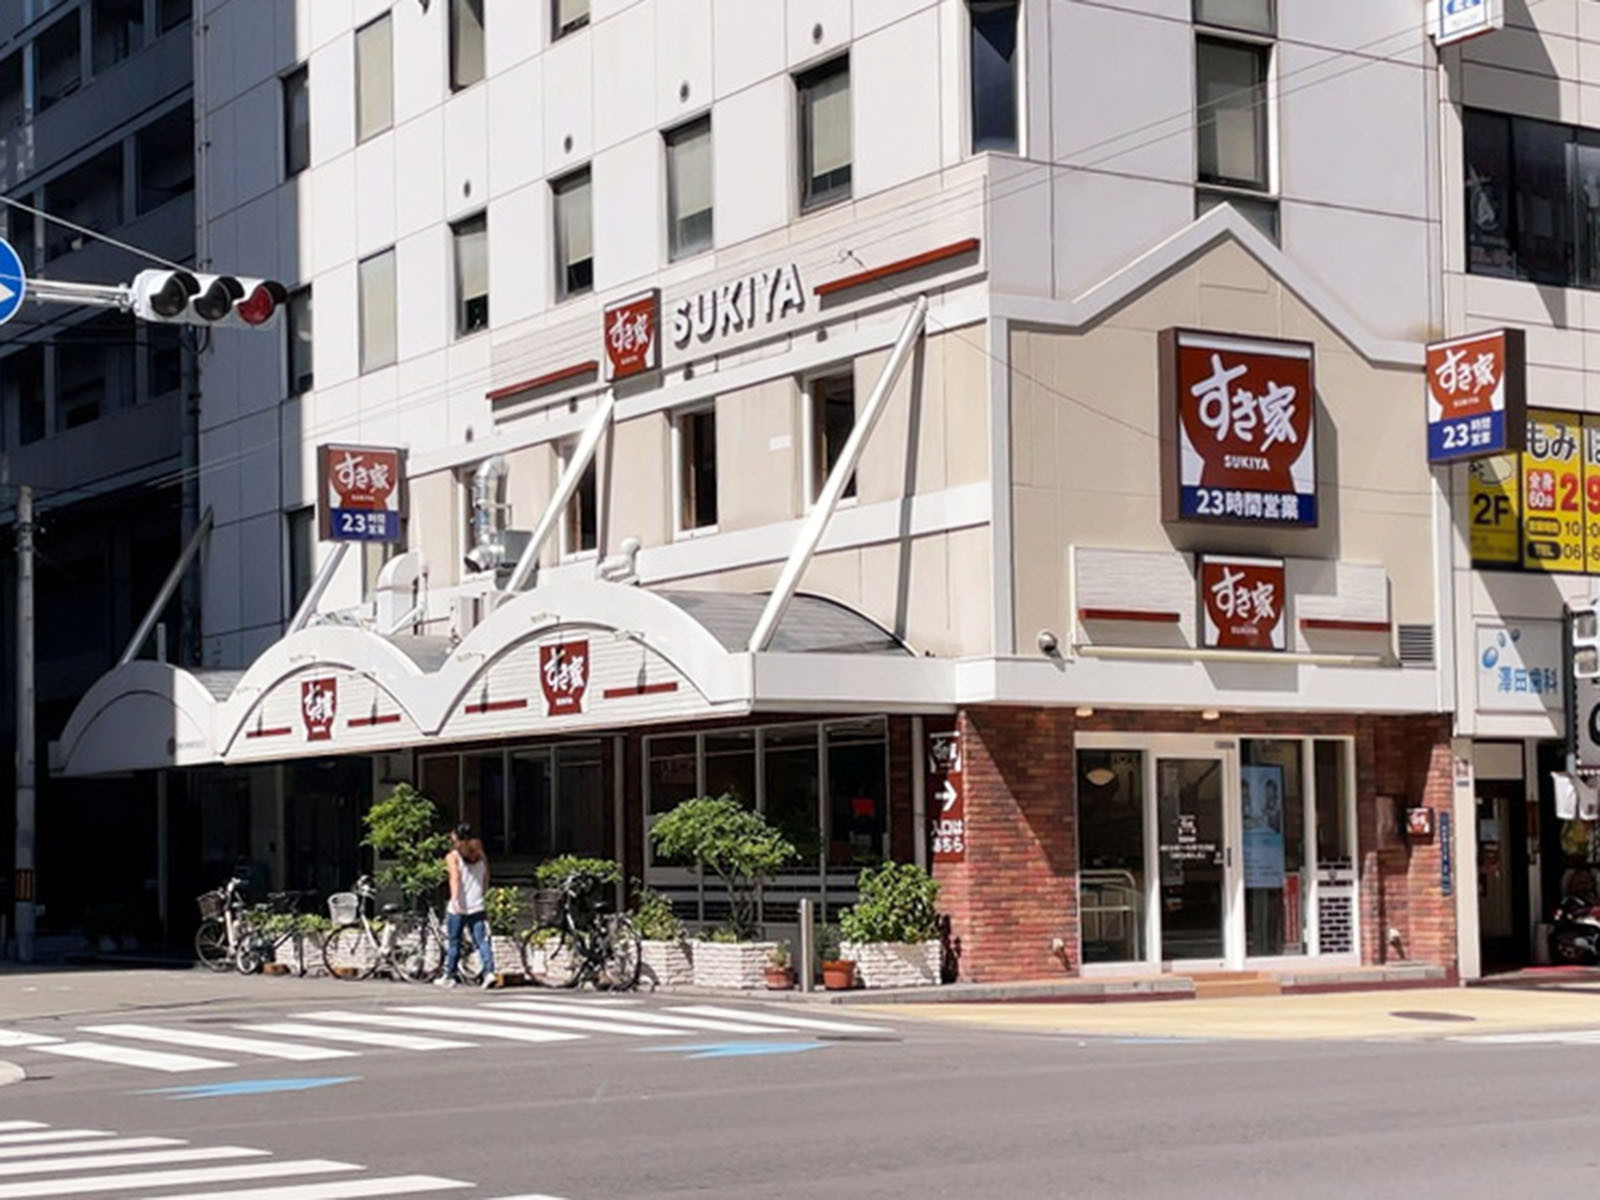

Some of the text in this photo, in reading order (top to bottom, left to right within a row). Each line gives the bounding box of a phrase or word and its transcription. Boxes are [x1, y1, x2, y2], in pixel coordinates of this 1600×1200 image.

[673, 263, 804, 347] SUKIYA
[610, 311, 648, 352] すき家
[1436, 350, 1495, 394] すき家
[1191, 353, 1297, 452] すき家
[1443, 424, 1469, 449] 23
[335, 452, 390, 493] すき家
[1224, 455, 1270, 471] SUKIYA
[342, 513, 366, 532] 23
[1197, 489, 1298, 519] 23時間営業
[1474, 493, 1510, 525] 2F
[1212, 566, 1275, 624] すき家
[544, 647, 584, 694] すき家
